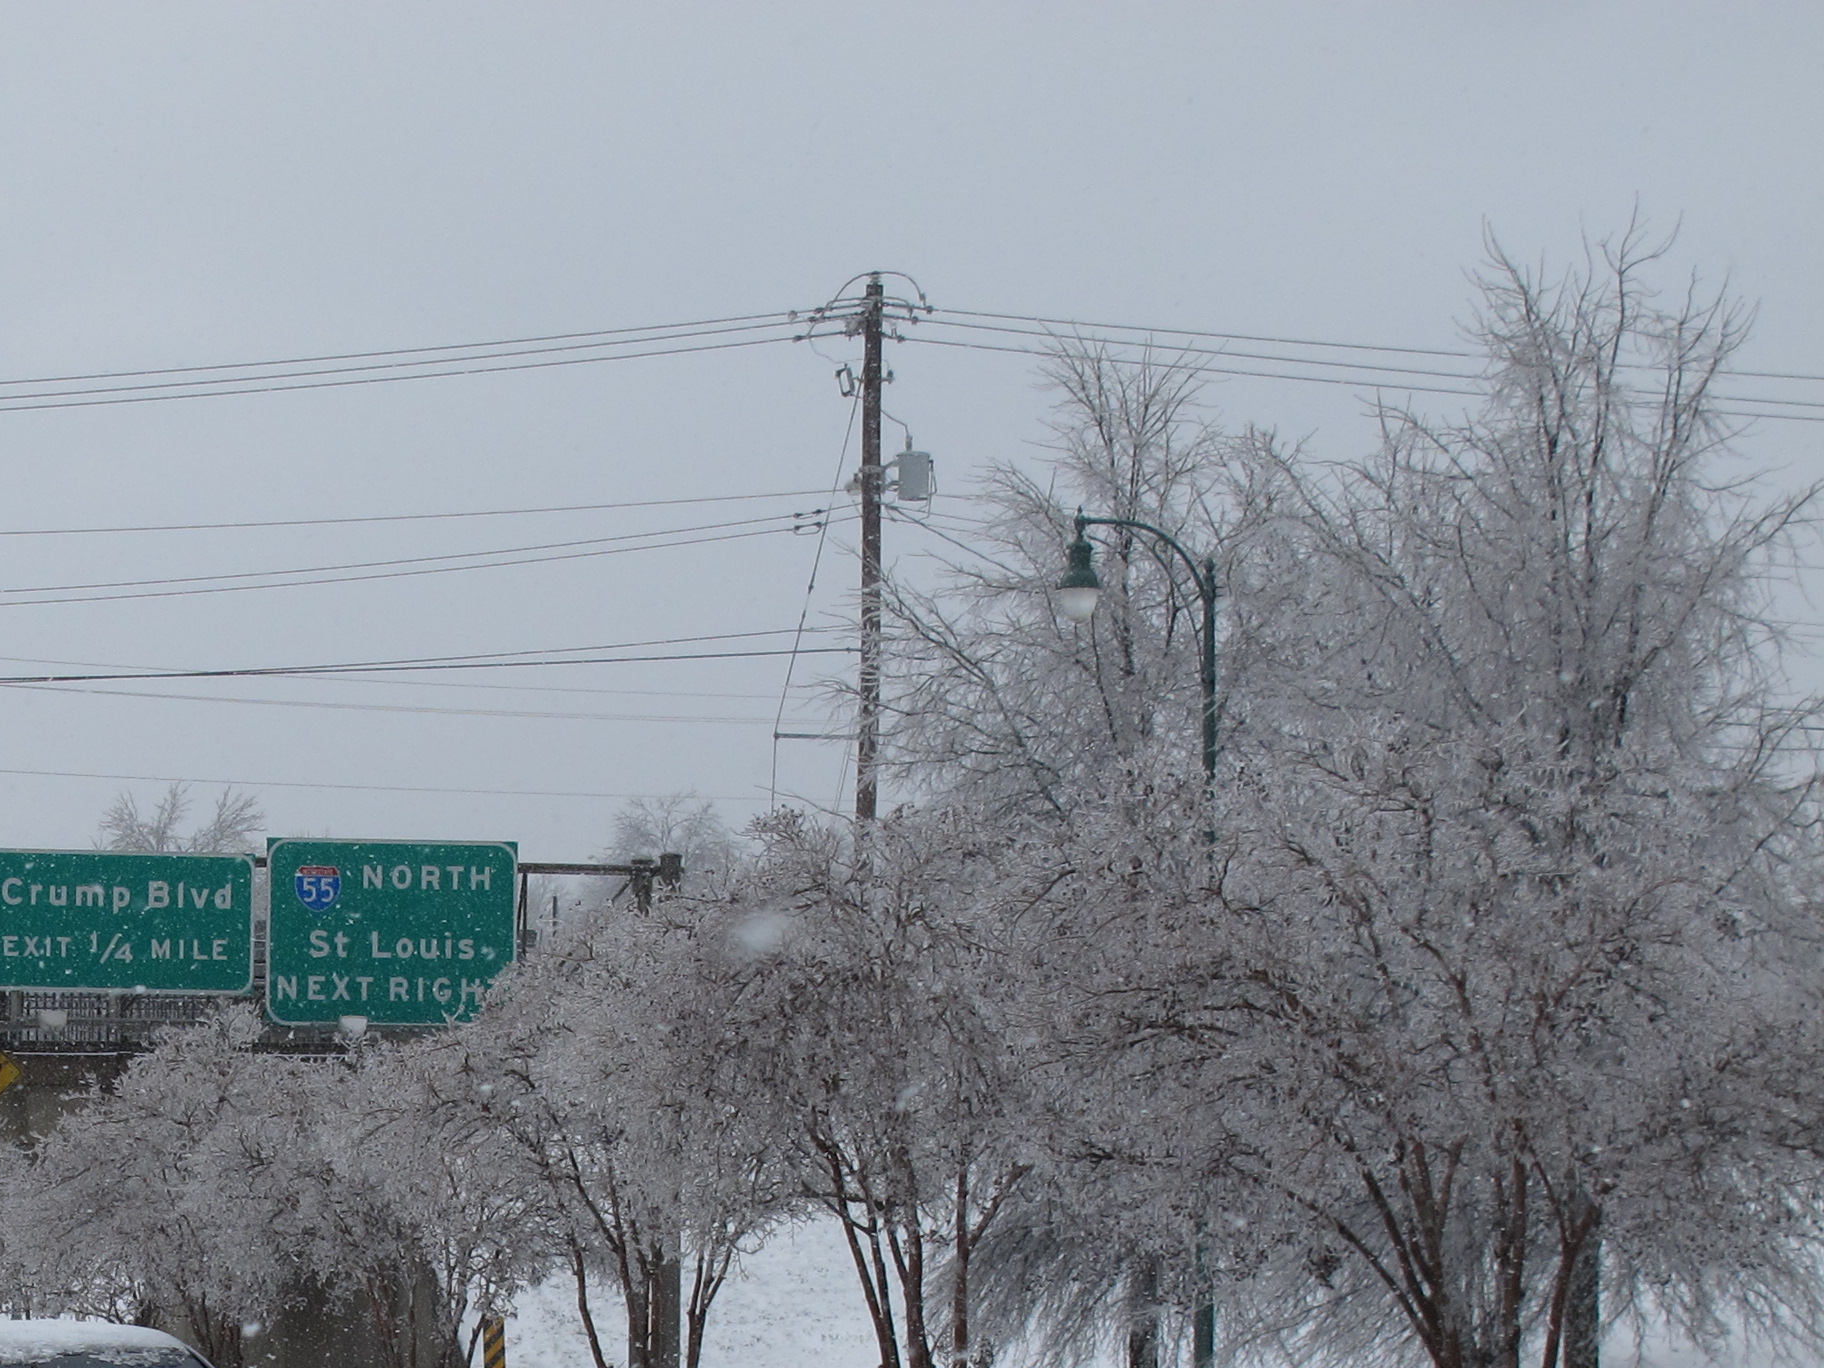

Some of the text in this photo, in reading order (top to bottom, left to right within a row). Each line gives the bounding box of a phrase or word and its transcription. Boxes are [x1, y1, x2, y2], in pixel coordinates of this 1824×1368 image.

[303, 877, 335, 903] 55
[363, 864, 491, 890] NORTH
[1, 877, 233, 914] Crump Blvd
[2, 931, 228, 965] EXIT 1/4 MILE
[309, 930, 475, 959] St Louis
[276, 975, 374, 1001] NEXT
